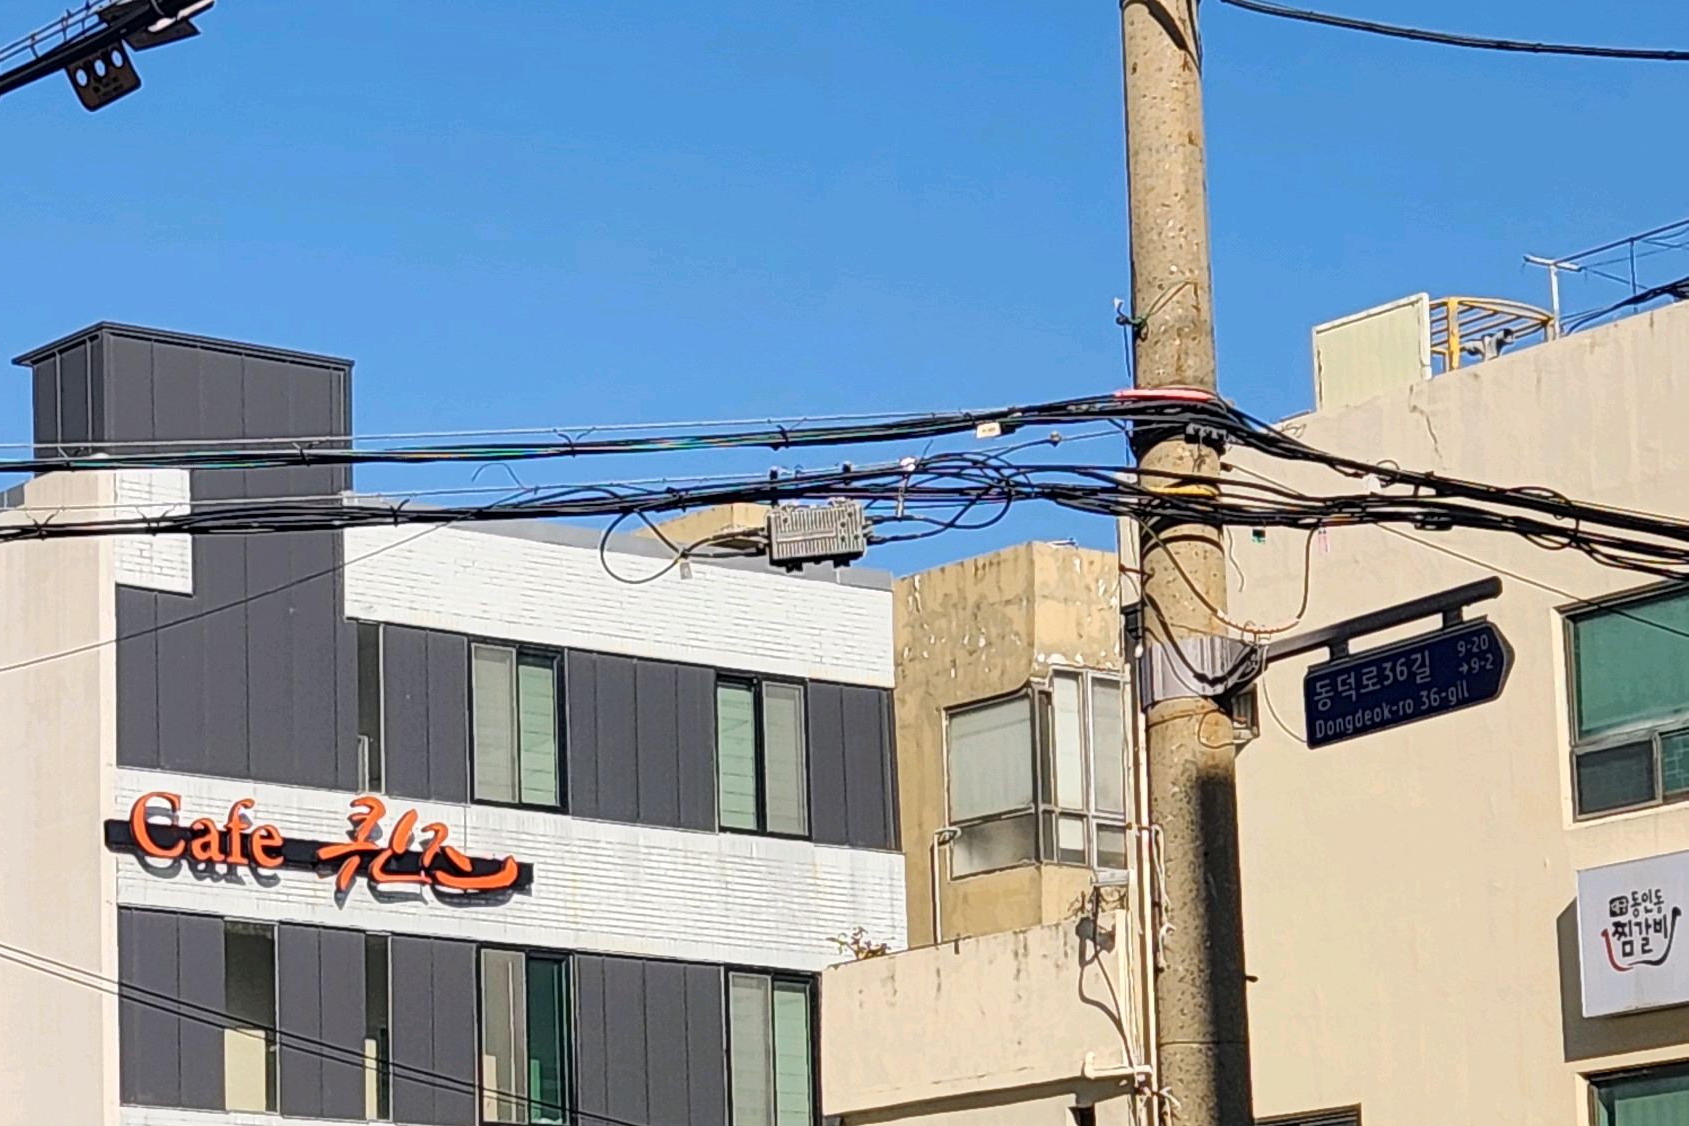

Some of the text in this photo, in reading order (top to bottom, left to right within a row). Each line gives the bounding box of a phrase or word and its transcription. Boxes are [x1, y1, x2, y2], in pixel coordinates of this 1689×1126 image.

[1457, 634, 1489, 657] 9-20
[1314, 650, 1432, 711] 동덕로36길
[1315, 679, 1469, 739] Dongdeok-ro 36-gil
[128, 790, 285, 868] Cafe
[1630, 888, 1665, 919] 동인동
[1611, 913, 1668, 958] 찜갈비
